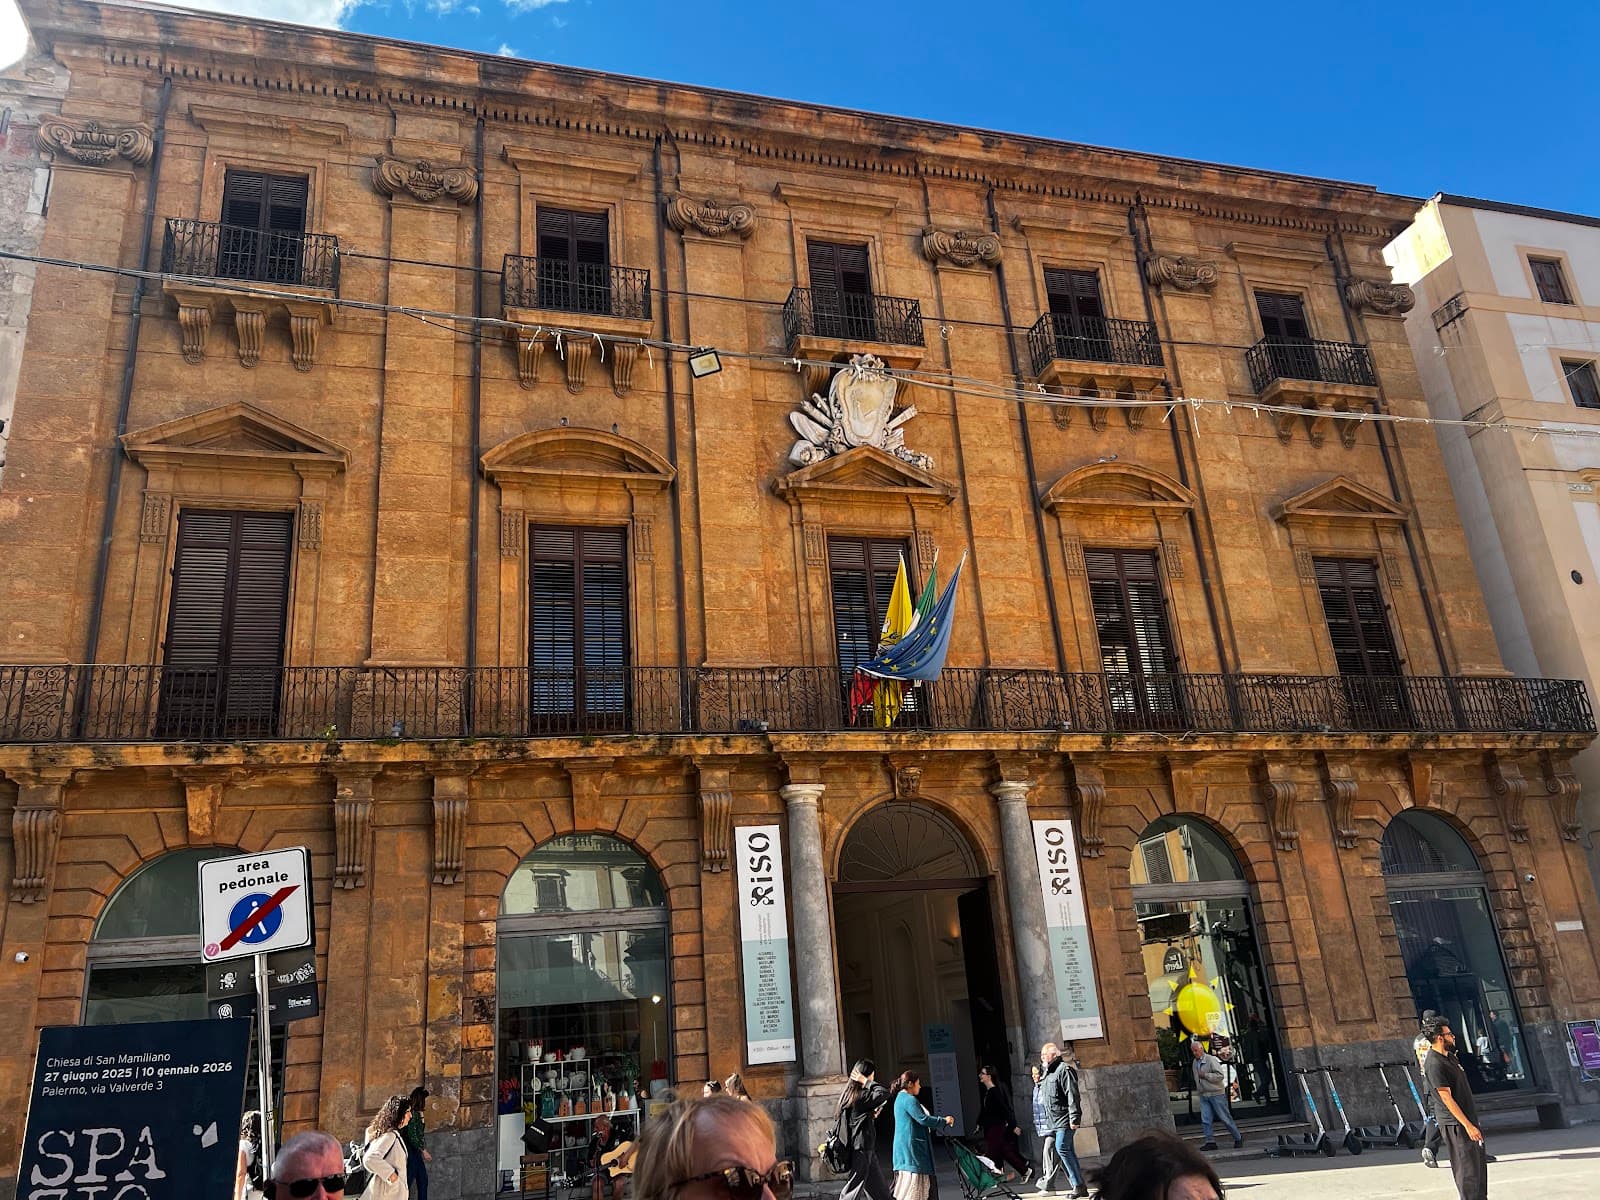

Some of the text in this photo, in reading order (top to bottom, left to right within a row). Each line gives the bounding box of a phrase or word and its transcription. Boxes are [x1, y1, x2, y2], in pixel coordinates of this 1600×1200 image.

[237, 860, 269, 872] area
[219, 872, 288, 893] pedonale
[47, 1053, 171, 1068] Chiesa di San Mamiliano
[44, 1072, 59, 1082] 27
[62, 1070, 98, 1083] giugno
[102, 1068, 132, 1079] 2025
[142, 1067, 154, 1077] 10
[157, 1065, 199, 1078] gennaio
[202, 1062, 232, 1073] 2026
[42, 1080, 163, 1096] Palermo, via Valverde 3
[31, 1126, 166, 1186] SPA
